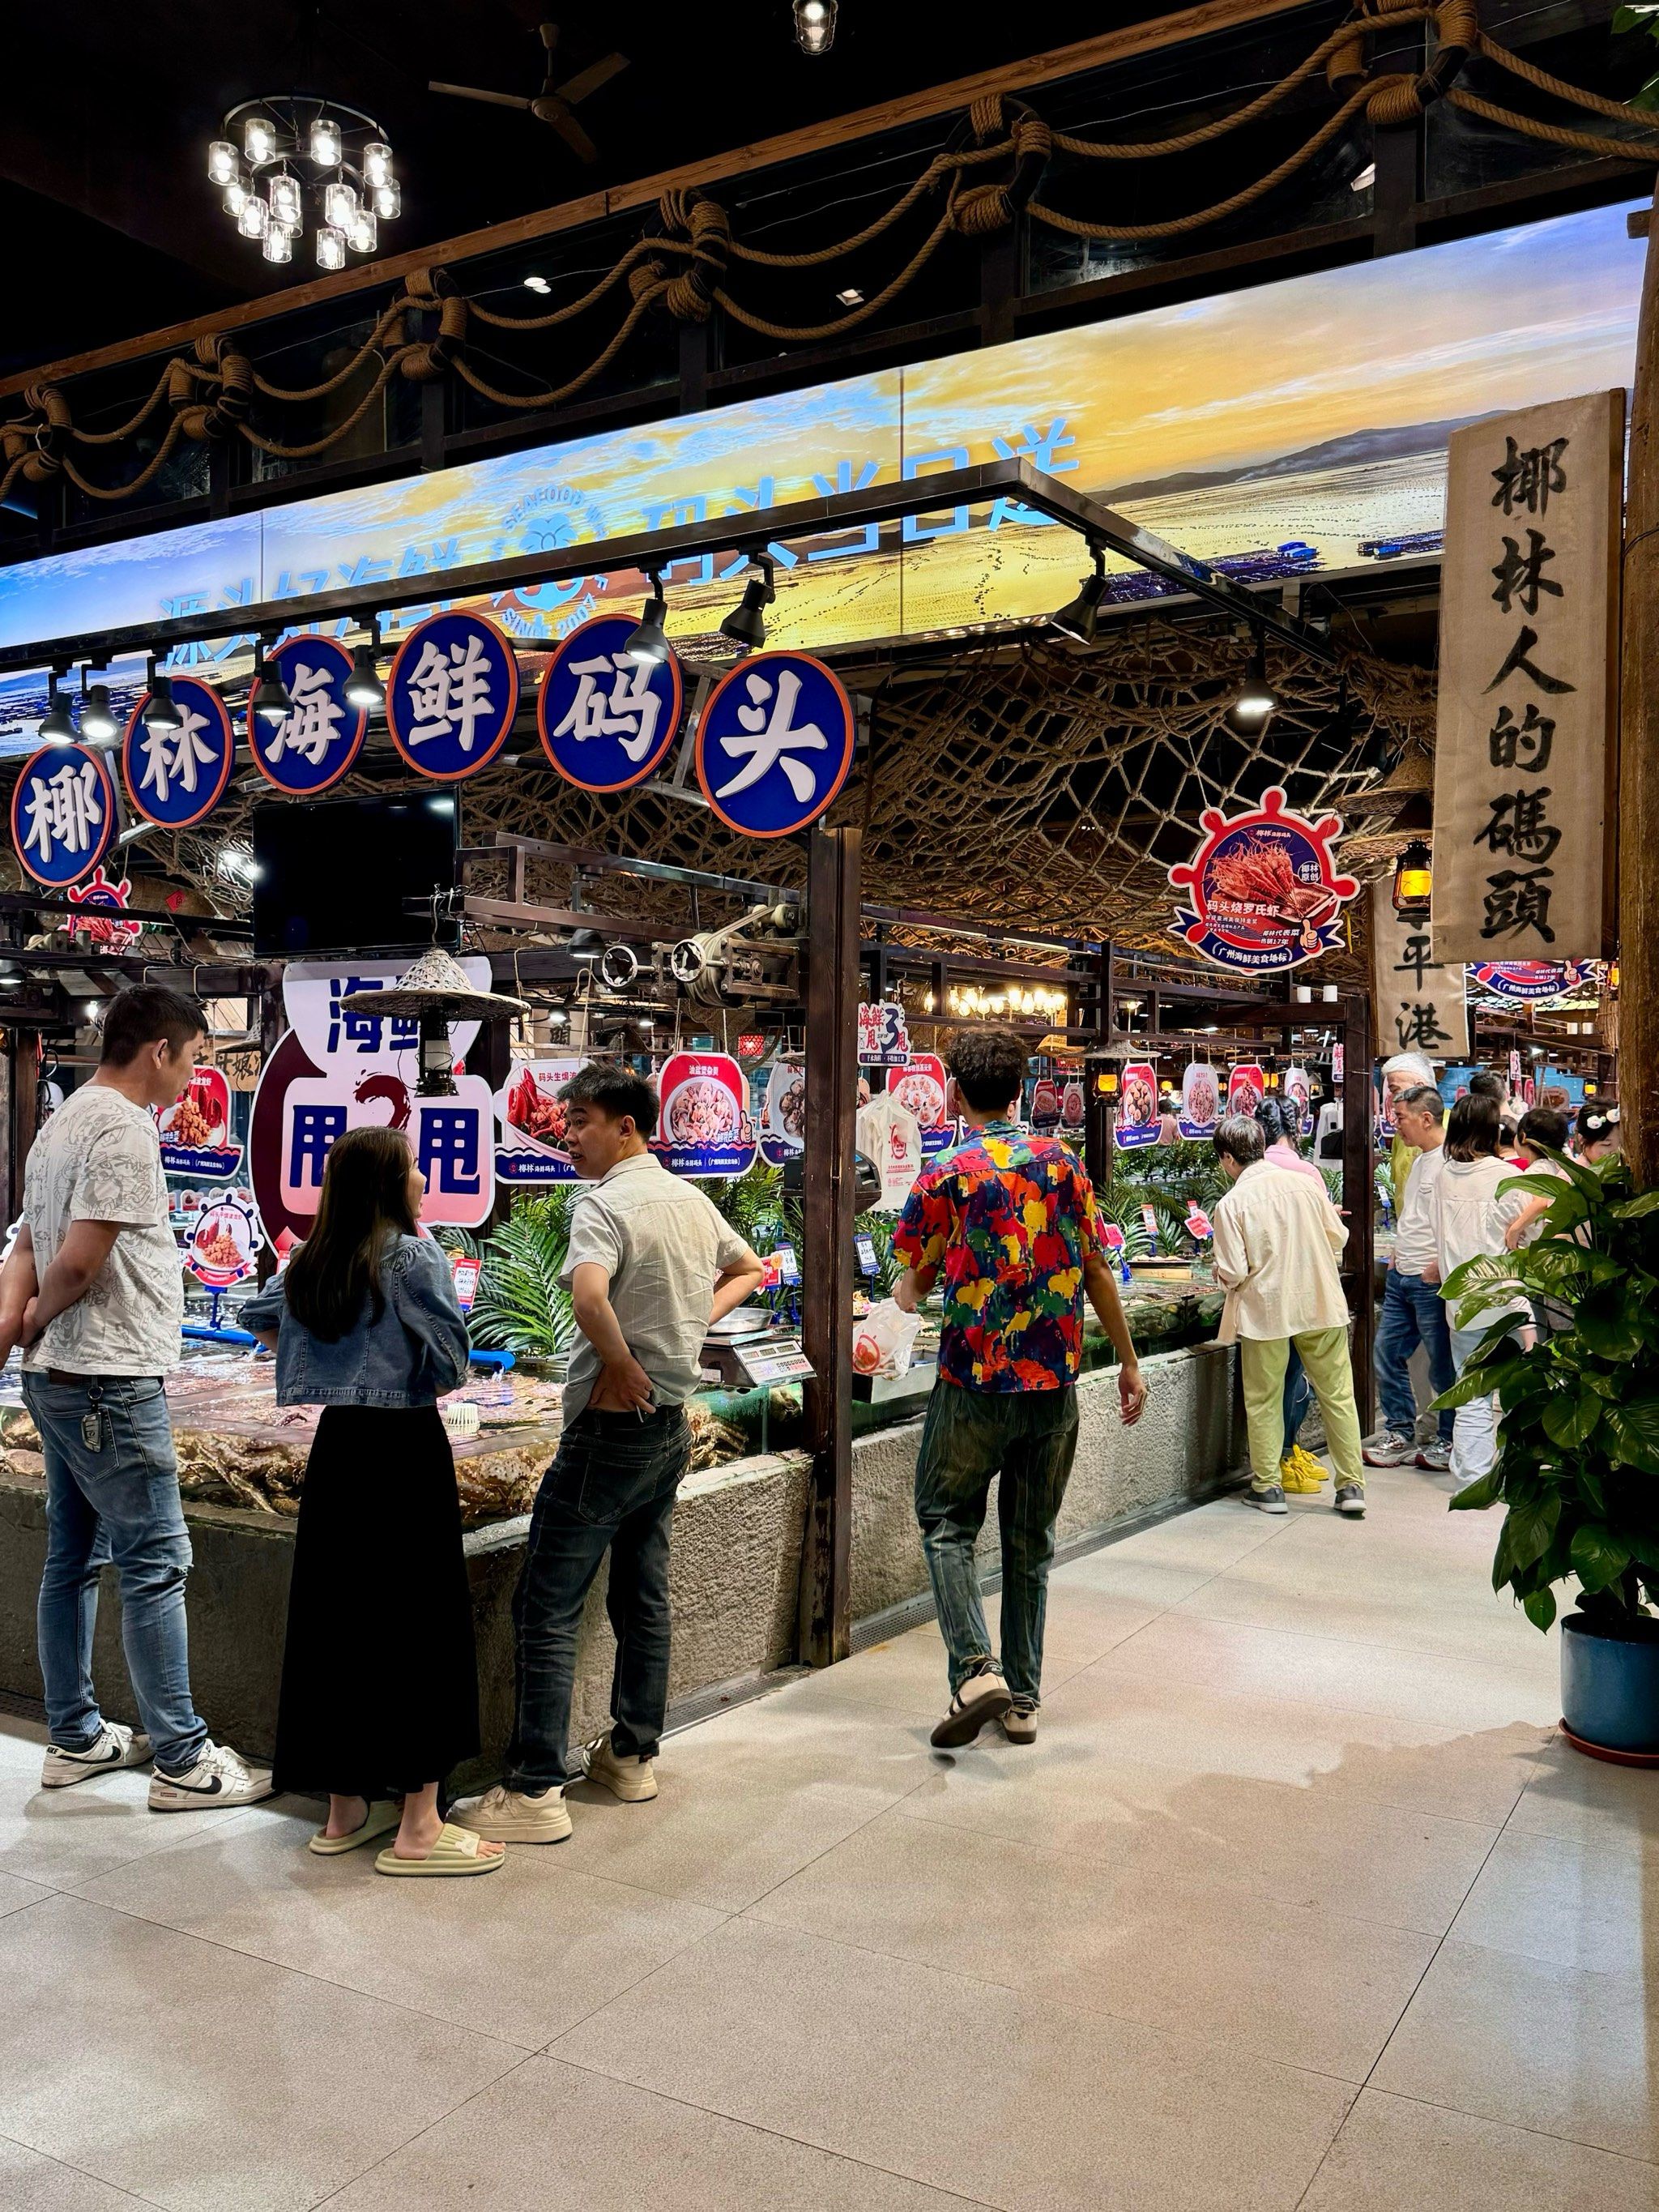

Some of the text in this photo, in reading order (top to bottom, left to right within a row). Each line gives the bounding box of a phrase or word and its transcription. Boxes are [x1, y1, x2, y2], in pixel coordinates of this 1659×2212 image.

[501, 485, 586, 534] SEAFOOD
[1473, 435, 1578, 945] 椰林人的碼頭
[1207, 899, 1281, 918] 码头烧罗氏虾
